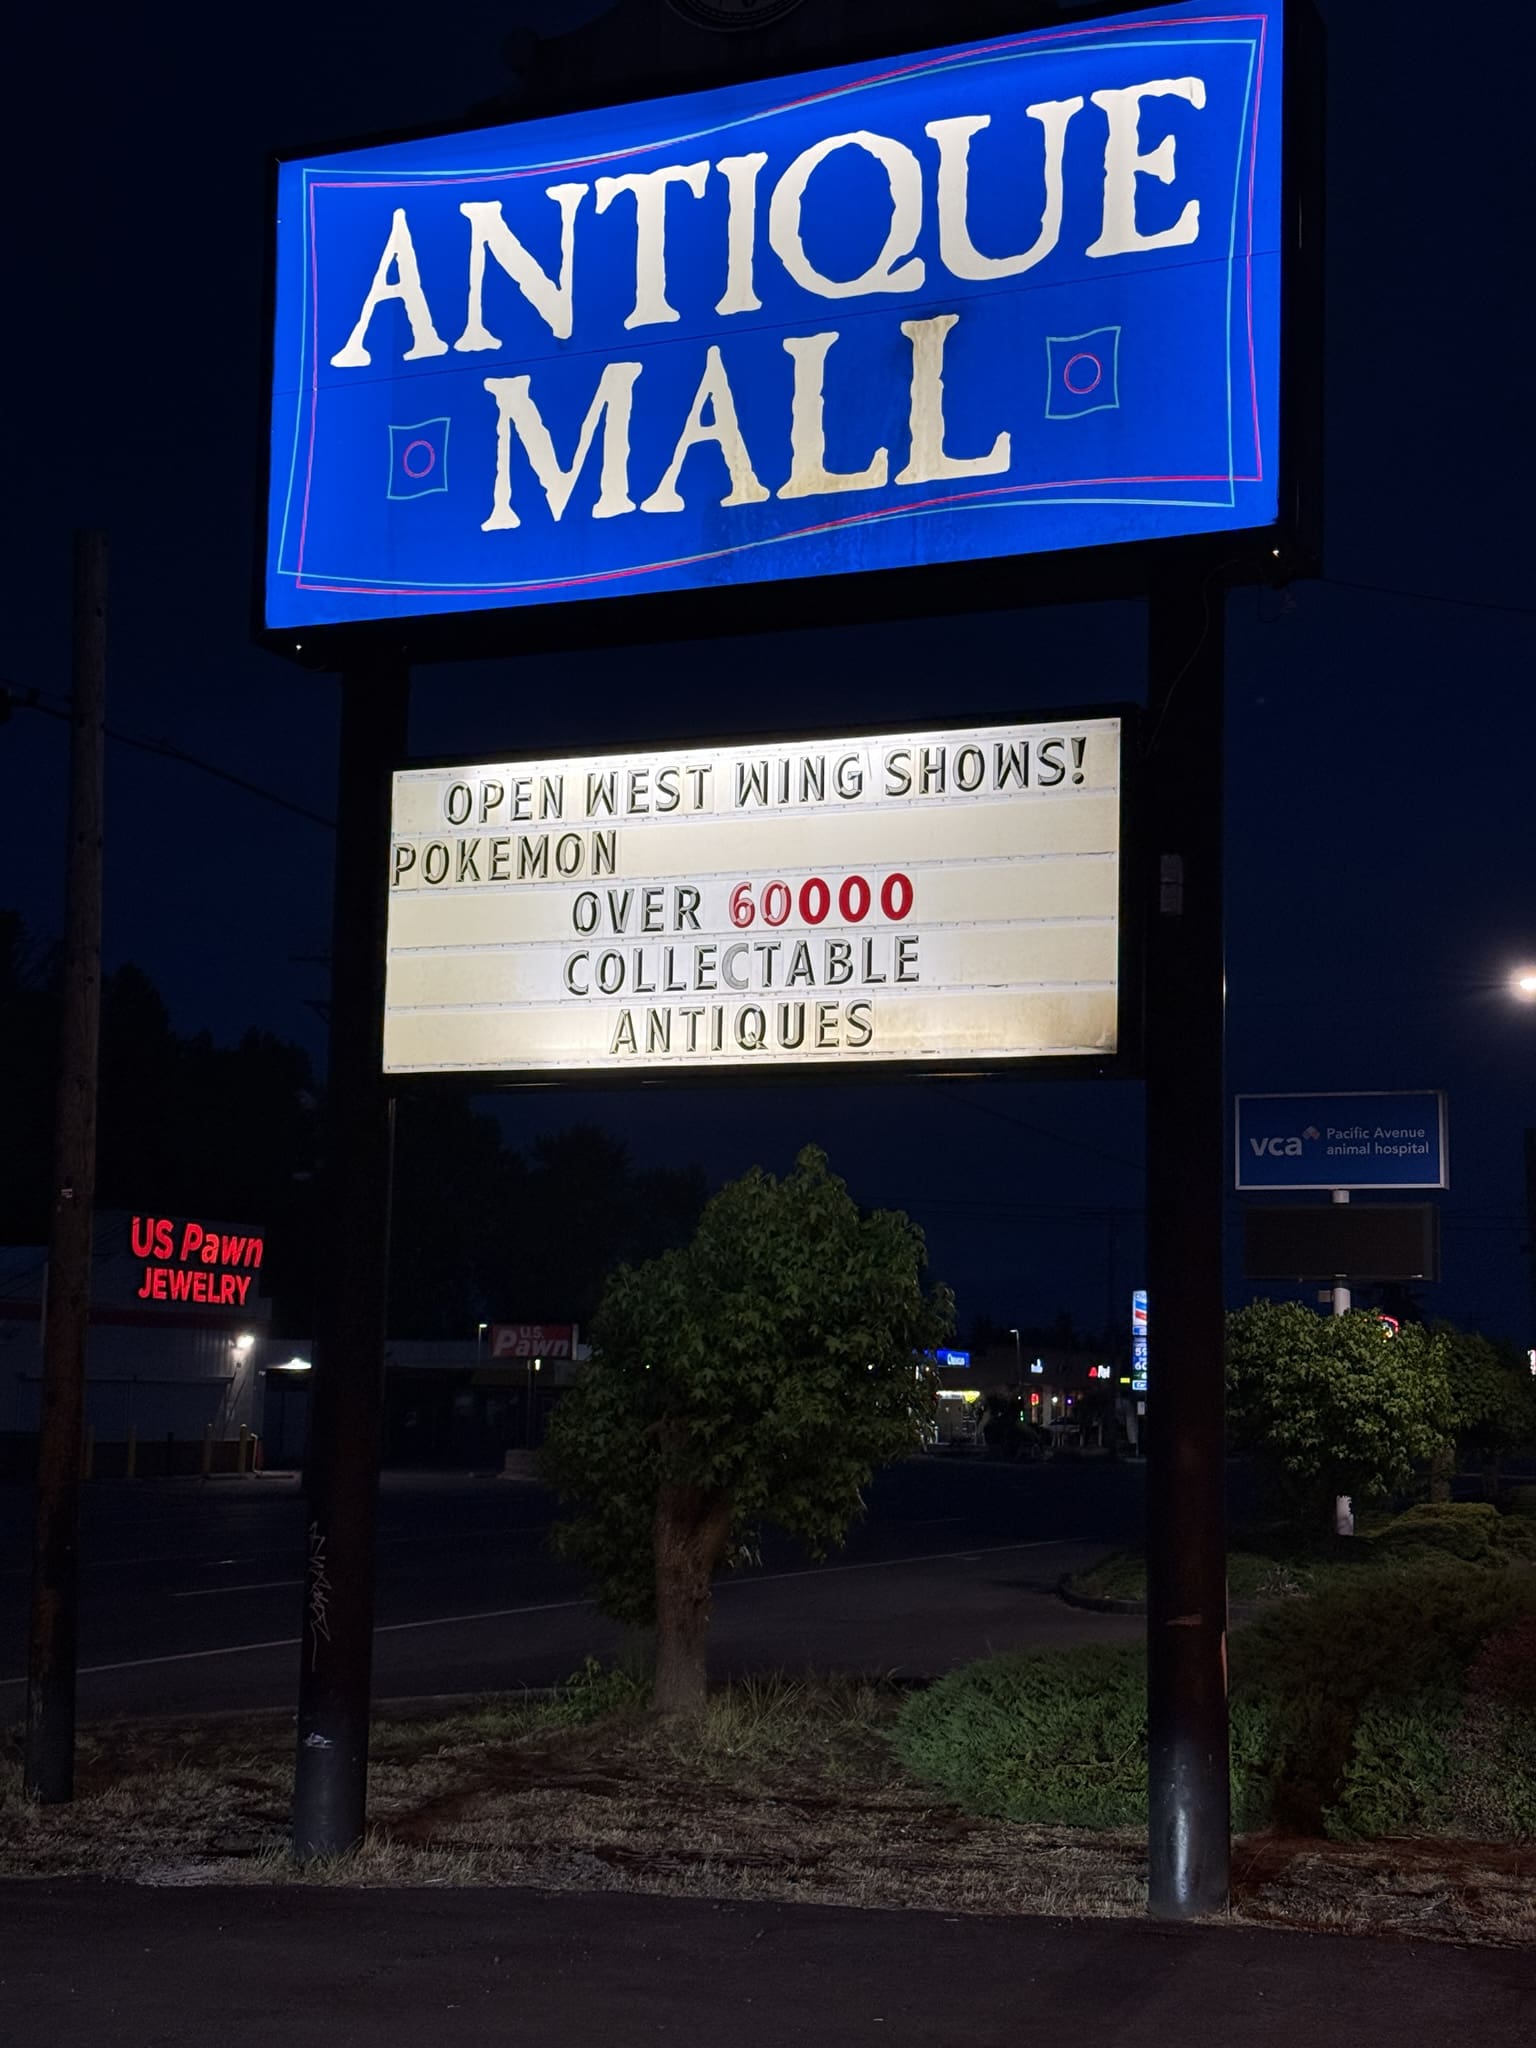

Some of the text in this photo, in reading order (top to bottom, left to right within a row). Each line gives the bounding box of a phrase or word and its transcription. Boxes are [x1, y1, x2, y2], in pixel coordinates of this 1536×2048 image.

[330, 76, 1207, 368] ANTIQUE
[480, 313, 1011, 532] MALL
[444, 736, 1086, 825] OPEN WEST WING SHOWS!
[392, 829, 617, 886] POKEMON
[572, 872, 914, 936] OVER 60000
[563, 935, 920, 996] COLLECTABLE
[609, 999, 873, 1054] ANTIQUES
[1250, 1136, 1302, 1156] vca
[1326, 1127, 1425, 1140] Pacific Avenue
[1326, 1141, 1429, 1157] animal hospital
[131, 1216, 264, 1268] US Pawn
[137, 1267, 251, 1305] JEWELRY
[492, 1329, 569, 1357] Pawn
